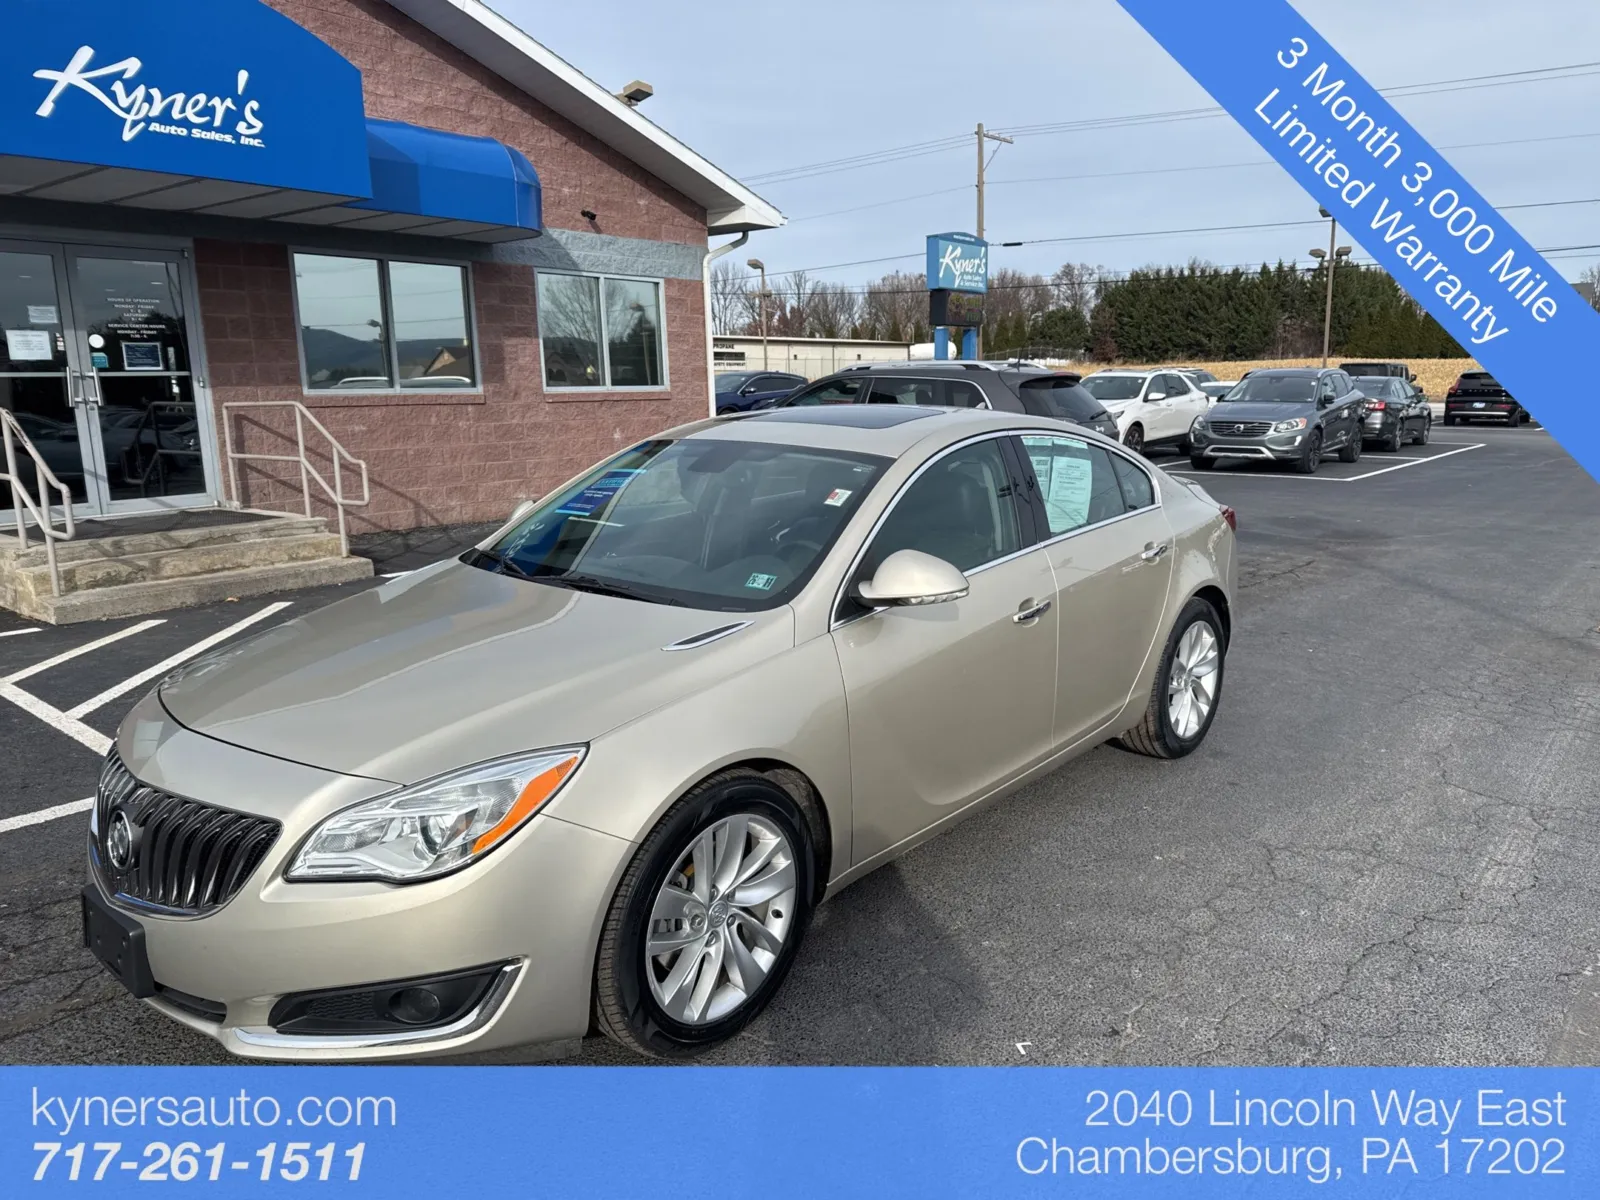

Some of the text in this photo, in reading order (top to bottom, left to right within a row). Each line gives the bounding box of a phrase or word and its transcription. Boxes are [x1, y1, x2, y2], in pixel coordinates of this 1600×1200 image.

[33, 45, 264, 142] Kyner's
[148, 121, 188, 136] Auto
[240, 135, 266, 148] Inc.
[939, 244, 986, 288] Kyner's
